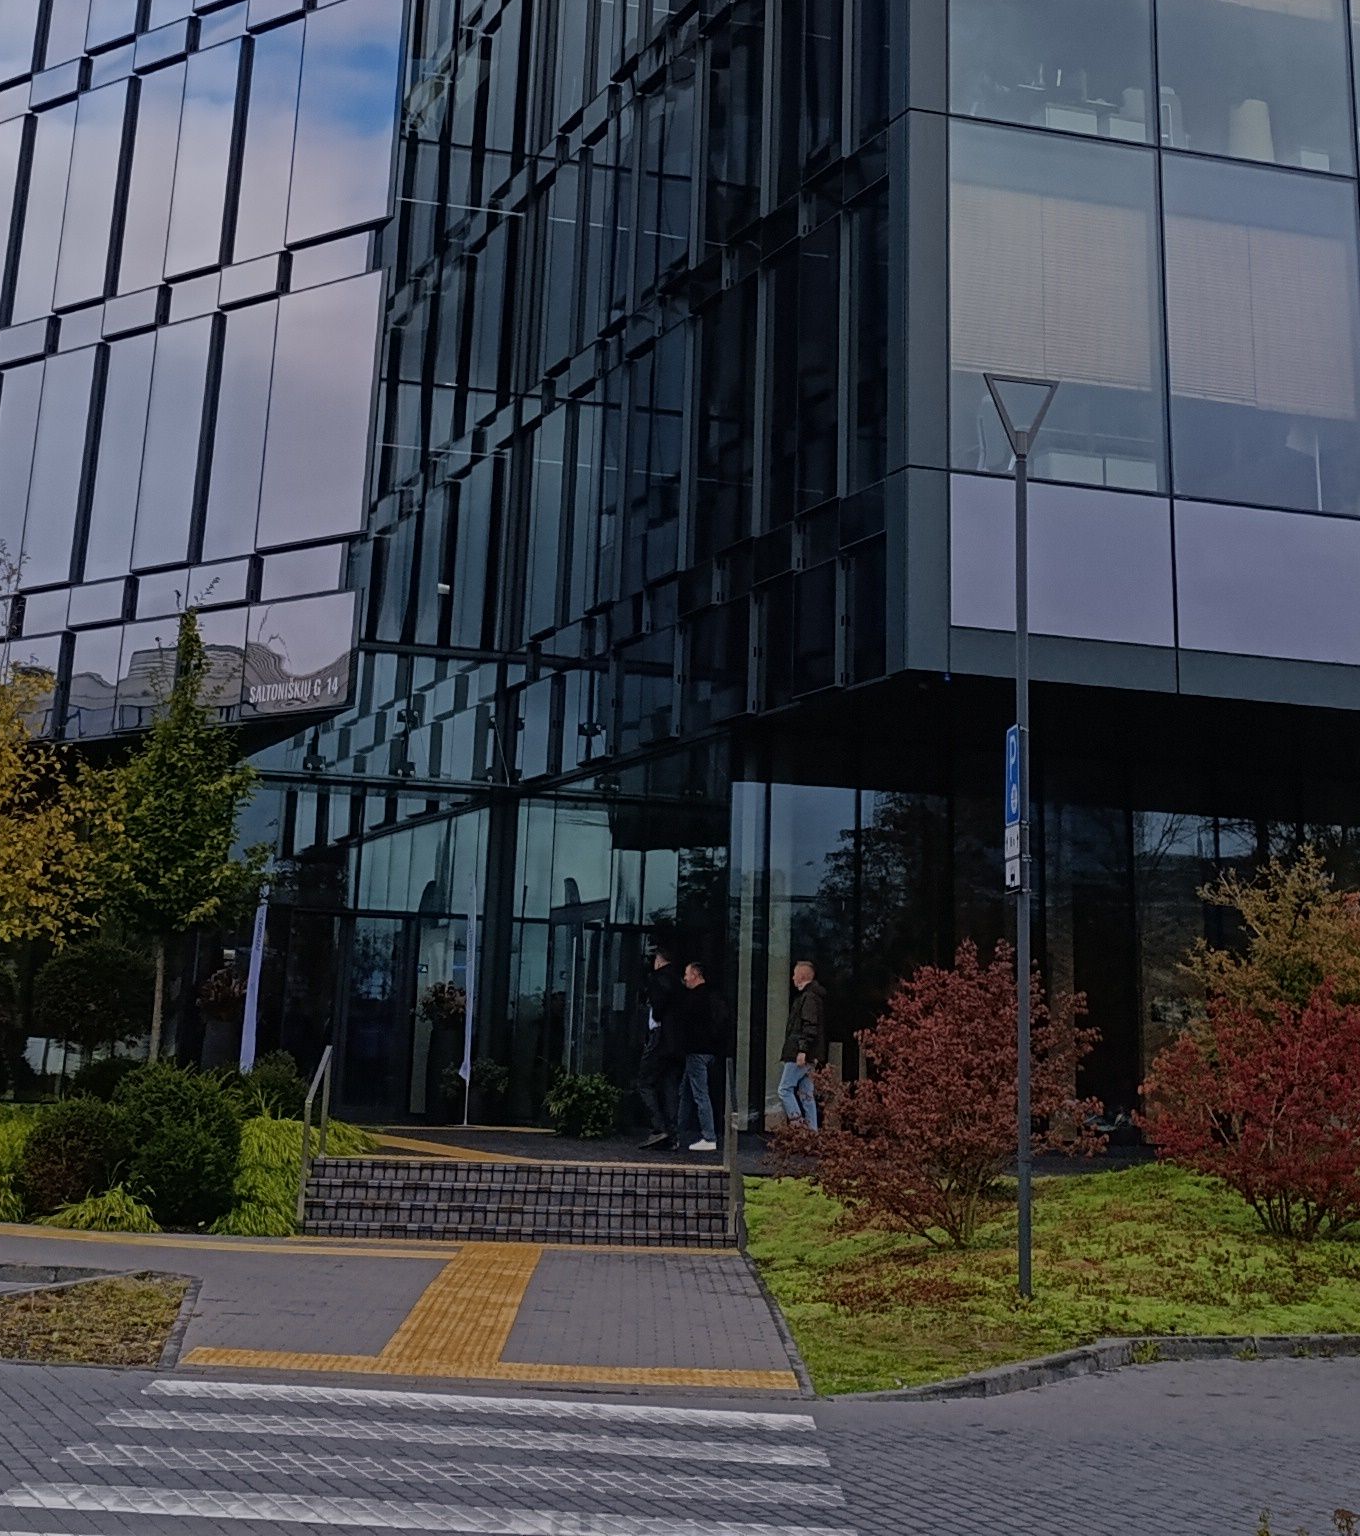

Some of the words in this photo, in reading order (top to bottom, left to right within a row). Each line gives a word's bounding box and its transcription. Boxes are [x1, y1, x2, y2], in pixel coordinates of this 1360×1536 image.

[249, 678, 312, 703] SALTONIŠKIŲ
[326, 677, 339, 695] 14
[1008, 734, 1017, 782] P
